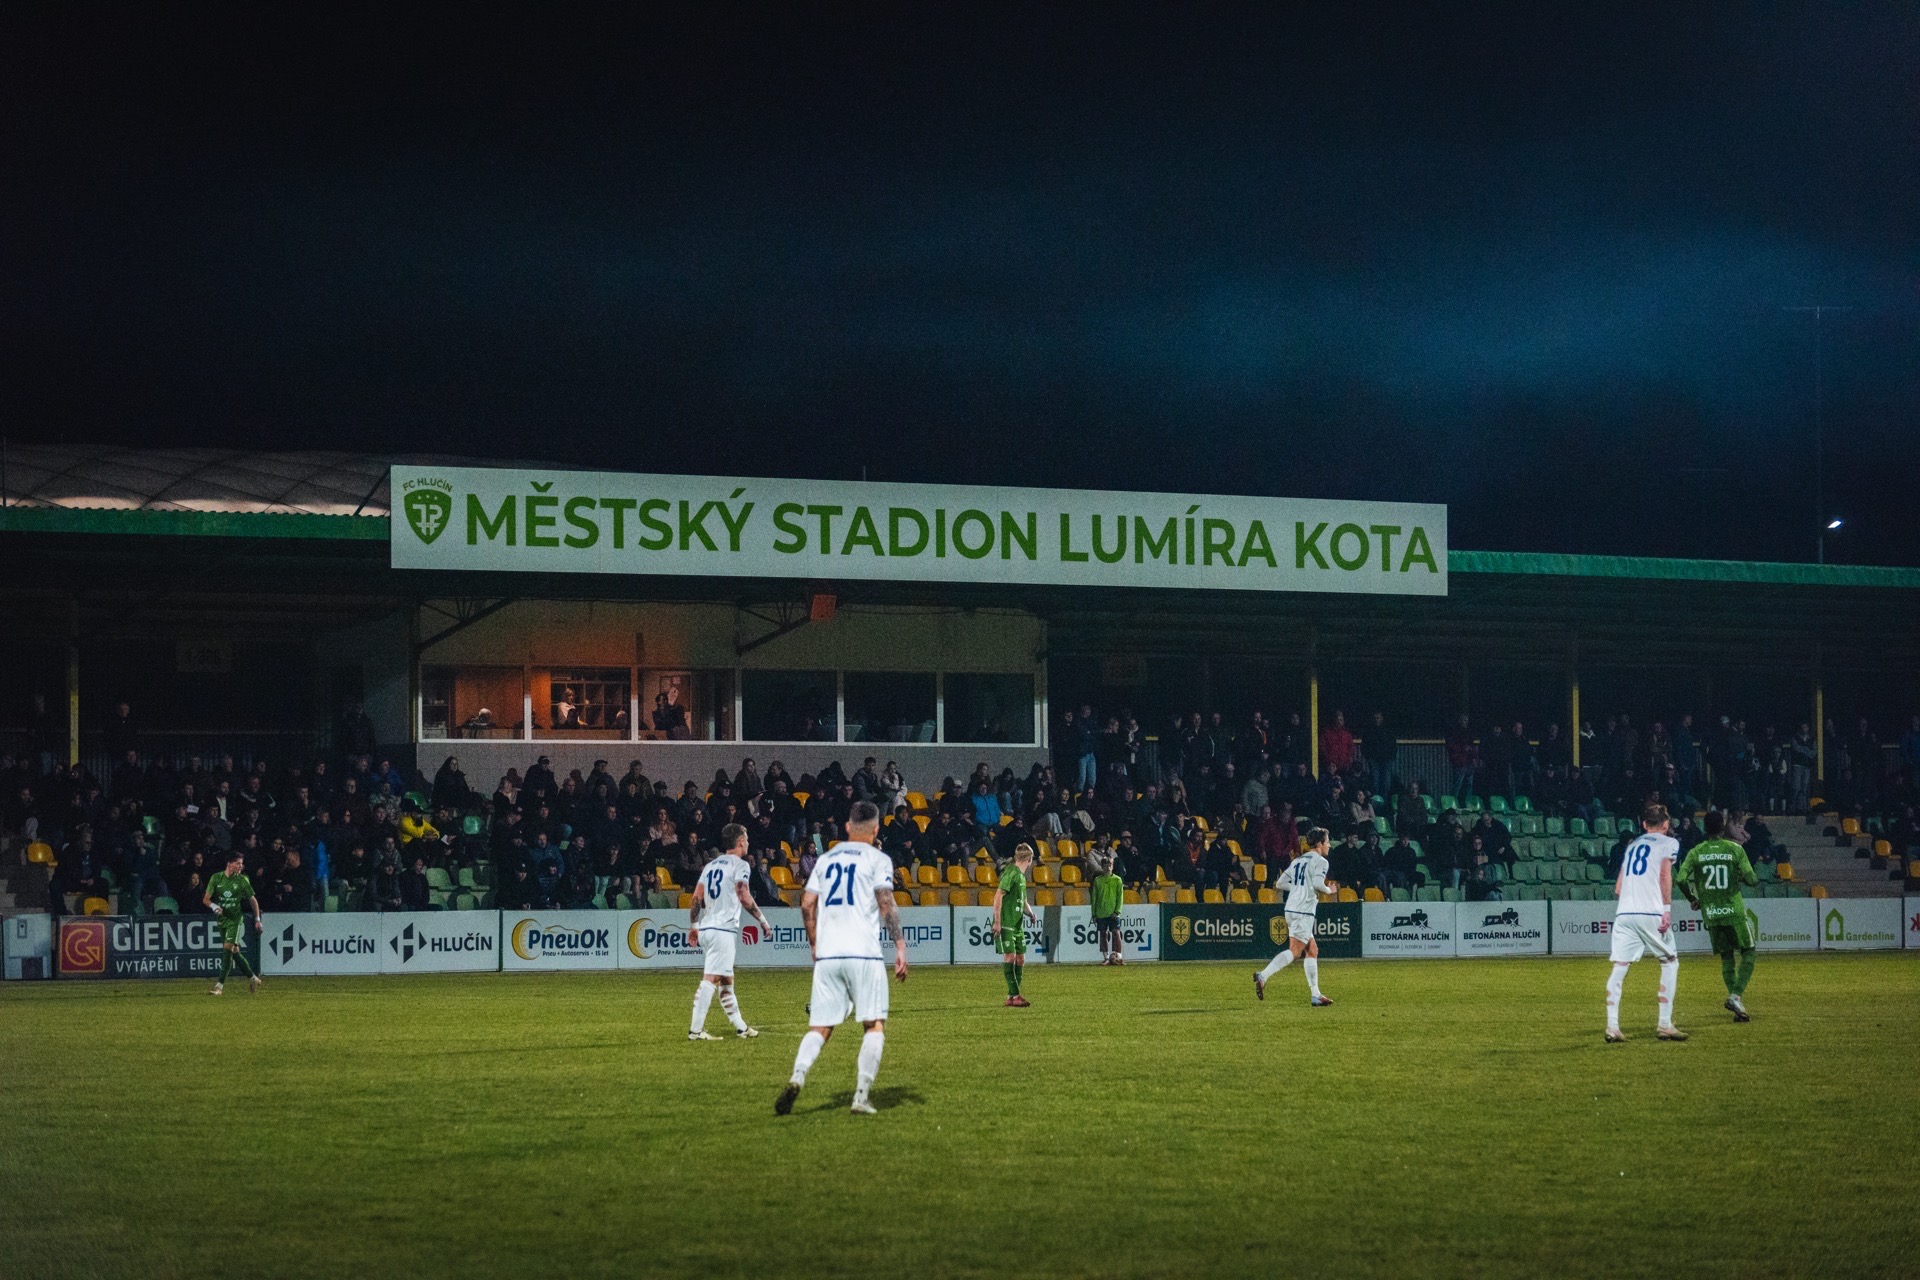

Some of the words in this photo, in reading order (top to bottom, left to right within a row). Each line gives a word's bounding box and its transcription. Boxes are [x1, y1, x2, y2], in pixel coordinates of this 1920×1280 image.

[402, 480, 415, 491] FC
[417, 477, 453, 492] HLUČÍN
[466, 481, 755, 552] MĚSTSKÝ
[772, 502, 1037, 560] STADION
[1060, 505, 1277, 568] LUMÍRA
[1295, 522, 1438, 574] KOTA
[1626, 844, 1651, 876] 18
[1294, 862, 1308, 886] 14
[1702, 864, 1729, 890] 20
[706, 868, 723, 900] 13
[825, 862, 856, 907] 21
[1194, 918, 1254, 937] Chlebiš
[1313, 916, 1351, 935] lebiš
[1463, 930, 1510, 940] BETONÁRNA
[1512, 929, 1541, 939] HLUČÍN
[311, 935, 375, 954] HLUČÍN
[431, 932, 492, 952] HLUČÍN
[528, 928, 609, 949] PneuOK
[1371, 931, 1419, 941] BETONÁRNA
[1421, 930, 1450, 941] HLUČÍN
[1760, 932, 1811, 942] Gardenline
[1845, 932, 1895, 941] Gardenline
[116, 956, 179, 973] VYTÁPĚNÍ
